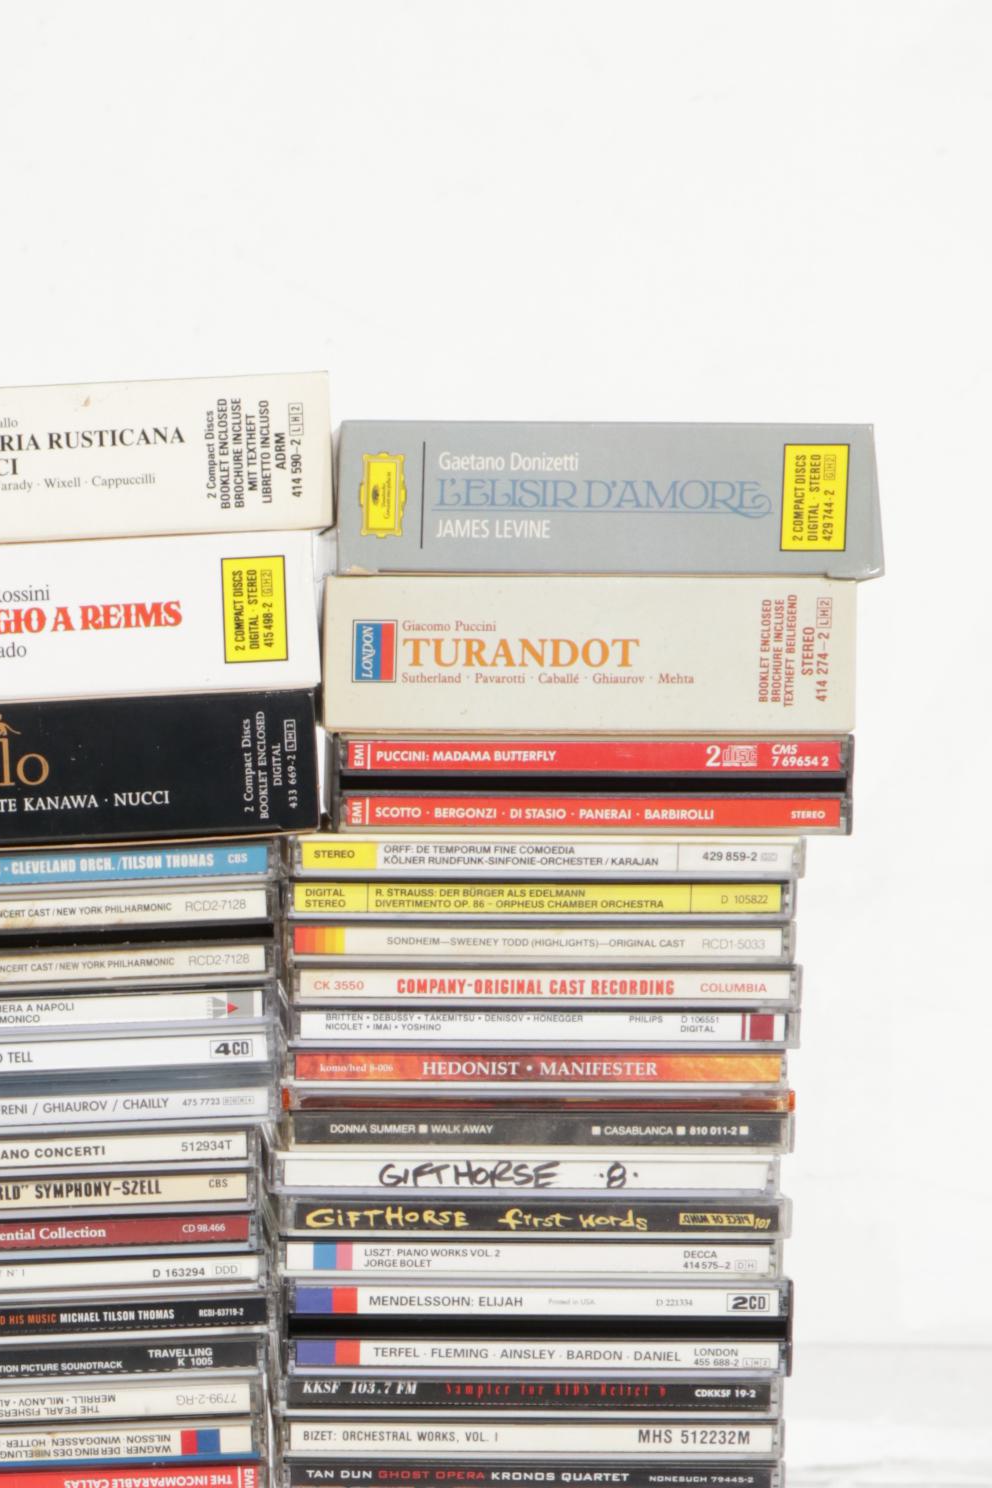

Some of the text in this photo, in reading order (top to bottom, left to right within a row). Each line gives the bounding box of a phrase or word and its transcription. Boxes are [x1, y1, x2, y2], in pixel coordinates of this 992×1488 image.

[48, 427, 185, 450] RUSTICANA
[438, 451, 579, 471] Gaetano Donizetti
[436, 519, 551, 539] JAMES LEVINE
[52, 606, 75, 631] A
[81, 600, 183, 630] REIMS
[401, 620, 497, 632] Giacomo Puccini
[402, 637, 640, 668] TURANDOT
[401, 672, 526, 685] Sutherland Pavarotti
[375, 750, 556, 763] PUCCINI: MADAMA BUTTERFLY
[23, 794, 98, 812] KANAWA
[114, 791, 170, 808] NUCCI
[374, 806, 715, 820] SCOTTO BARBIROLLI
[700, 983, 767, 992] COLUMBIA
[7, 1051, 33, 1064] TELL
[422, 1060, 658, 1076] HEDONIST MANIFESTER
[122, 1097, 169, 1110] CHAILLY
[330, 1124, 493, 1134] DONNA SUMMER WALK AWAY
[38, 1225, 107, 1241] Collection
[369, 1295, 524, 1308] MENDELSSOHN: ELIJAH
[430, 1348, 681, 1362] FLEMING DANIEL
[637, 1429, 751, 1445] MHS 512232M
[491, 1471, 630, 1483] KRONOS QUARTET
